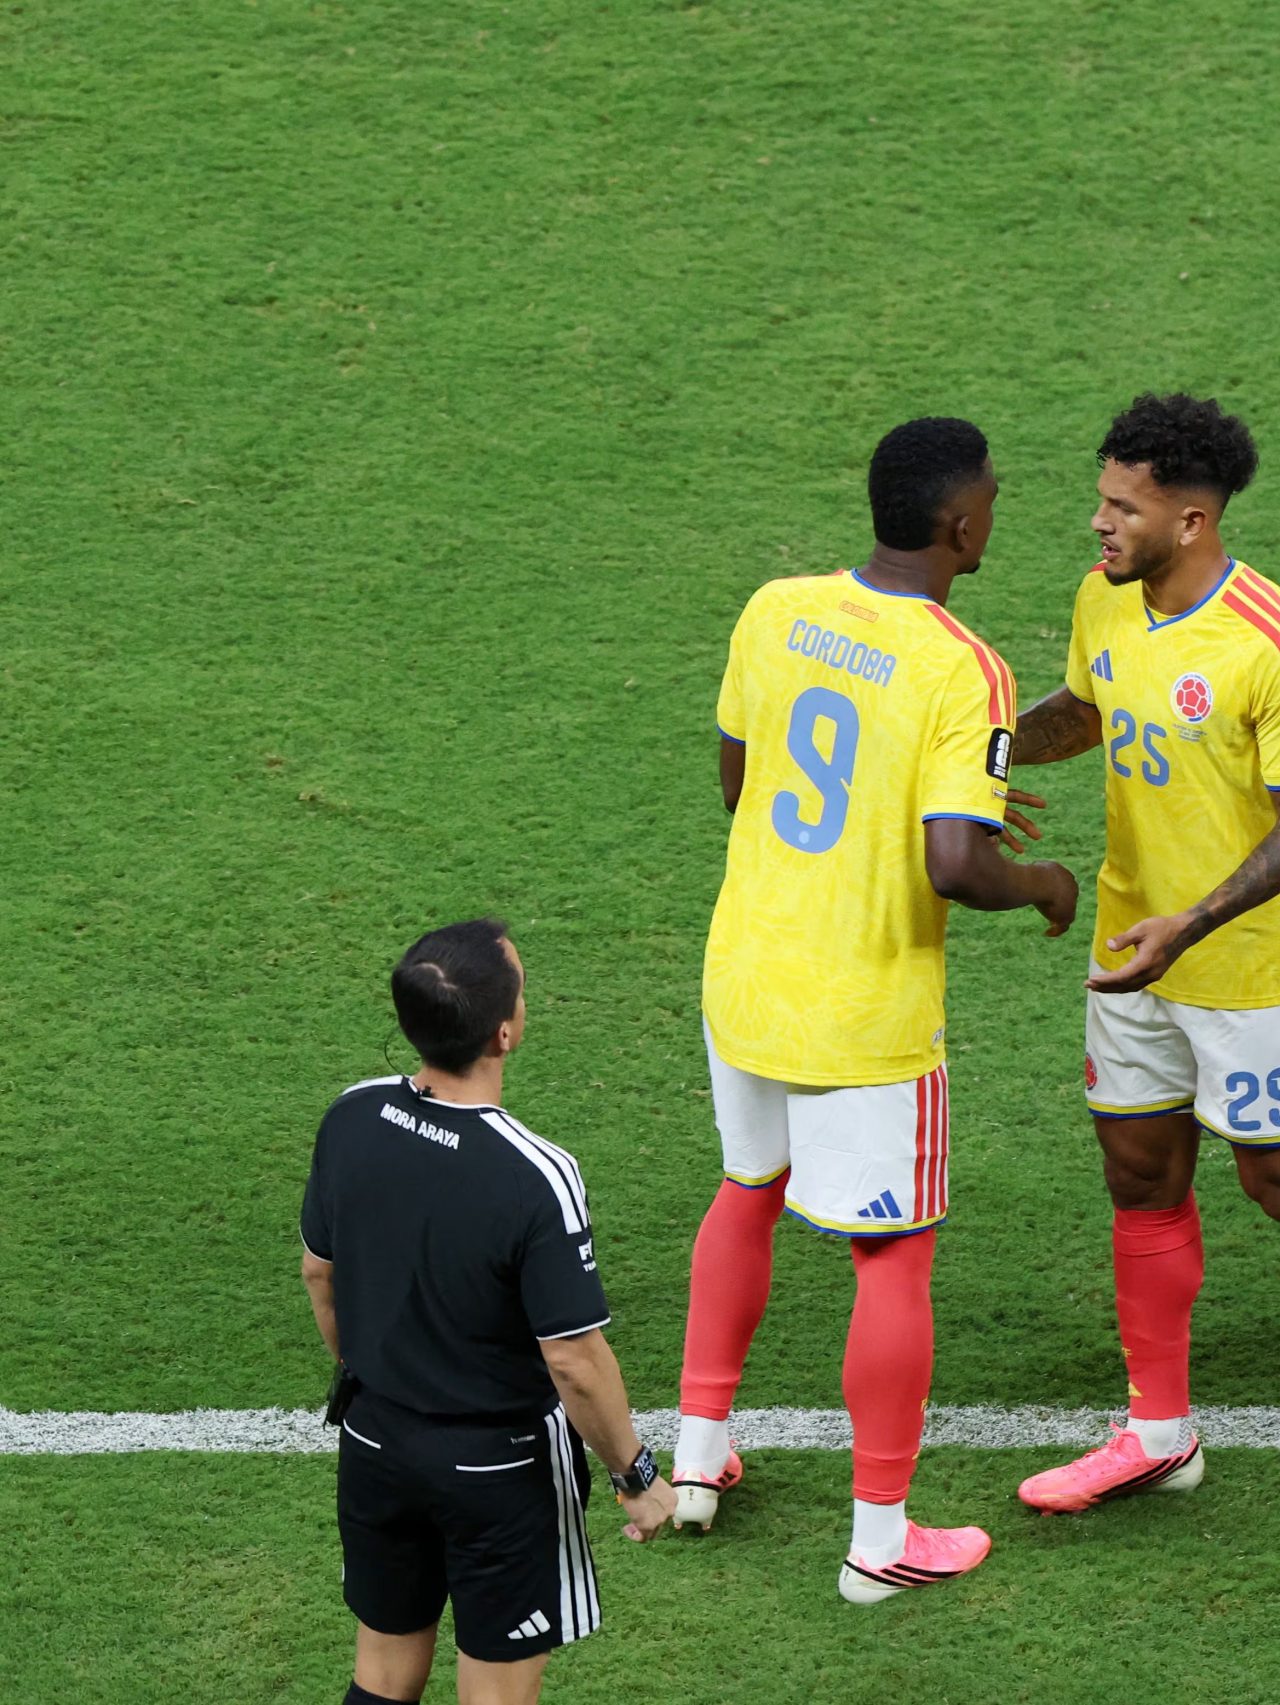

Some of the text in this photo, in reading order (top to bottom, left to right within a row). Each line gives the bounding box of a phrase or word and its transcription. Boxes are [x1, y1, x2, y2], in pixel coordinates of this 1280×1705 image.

[787, 619, 896, 687] CORDOBA
[771, 687, 860, 853] 9
[1110, 708, 1170, 787] 25
[380, 1103, 460, 1150] MORA ARAYA
